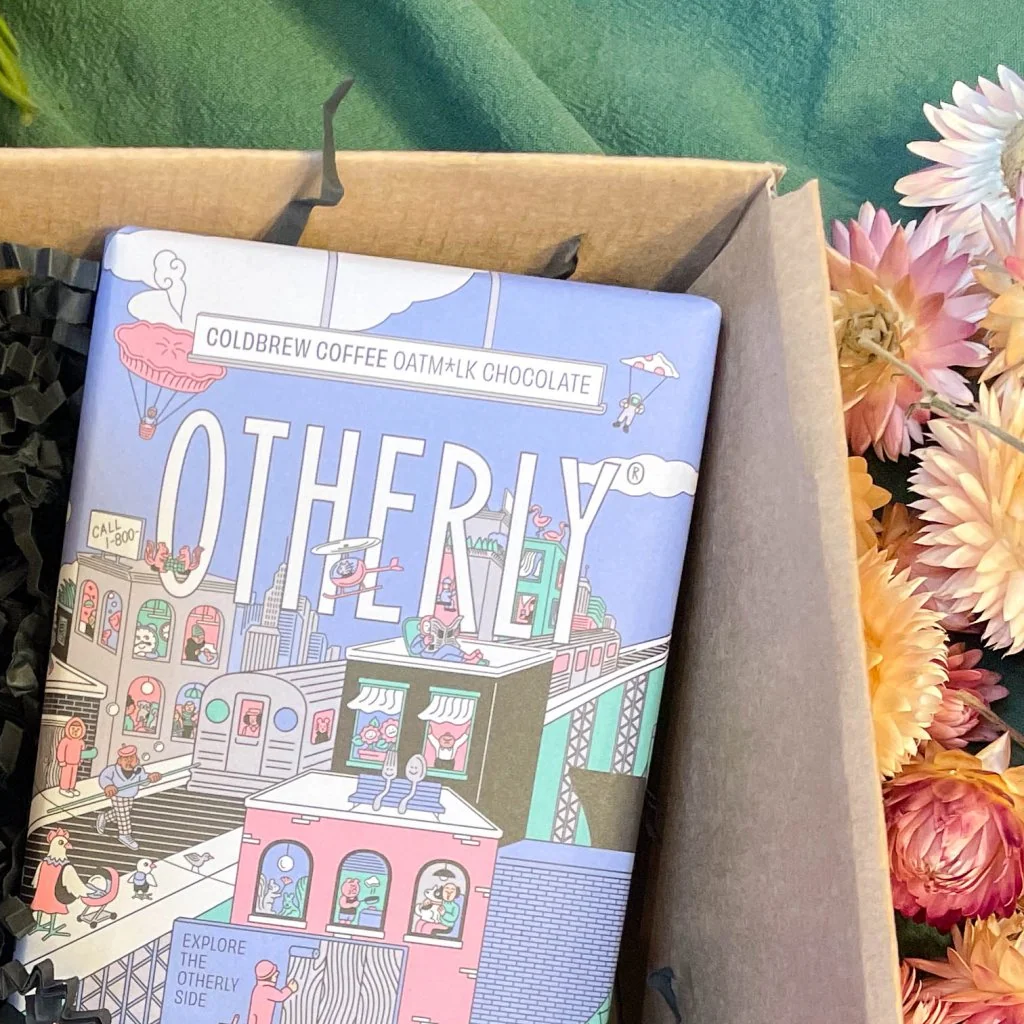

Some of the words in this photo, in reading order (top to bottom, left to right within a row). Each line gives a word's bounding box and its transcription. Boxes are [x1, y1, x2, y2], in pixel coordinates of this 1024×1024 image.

[206, 327, 312, 358] COLDBREW
[316, 341, 388, 368] COFFEE
[482, 362, 592, 395] CHOCOLATE
[92, 519, 122, 539] CALL
[182, 933, 247, 955] EXPLORE
[180, 951, 208, 969] THE
[177, 970, 240, 992] OTHERLY
[174, 989, 207, 1008] SIDE
